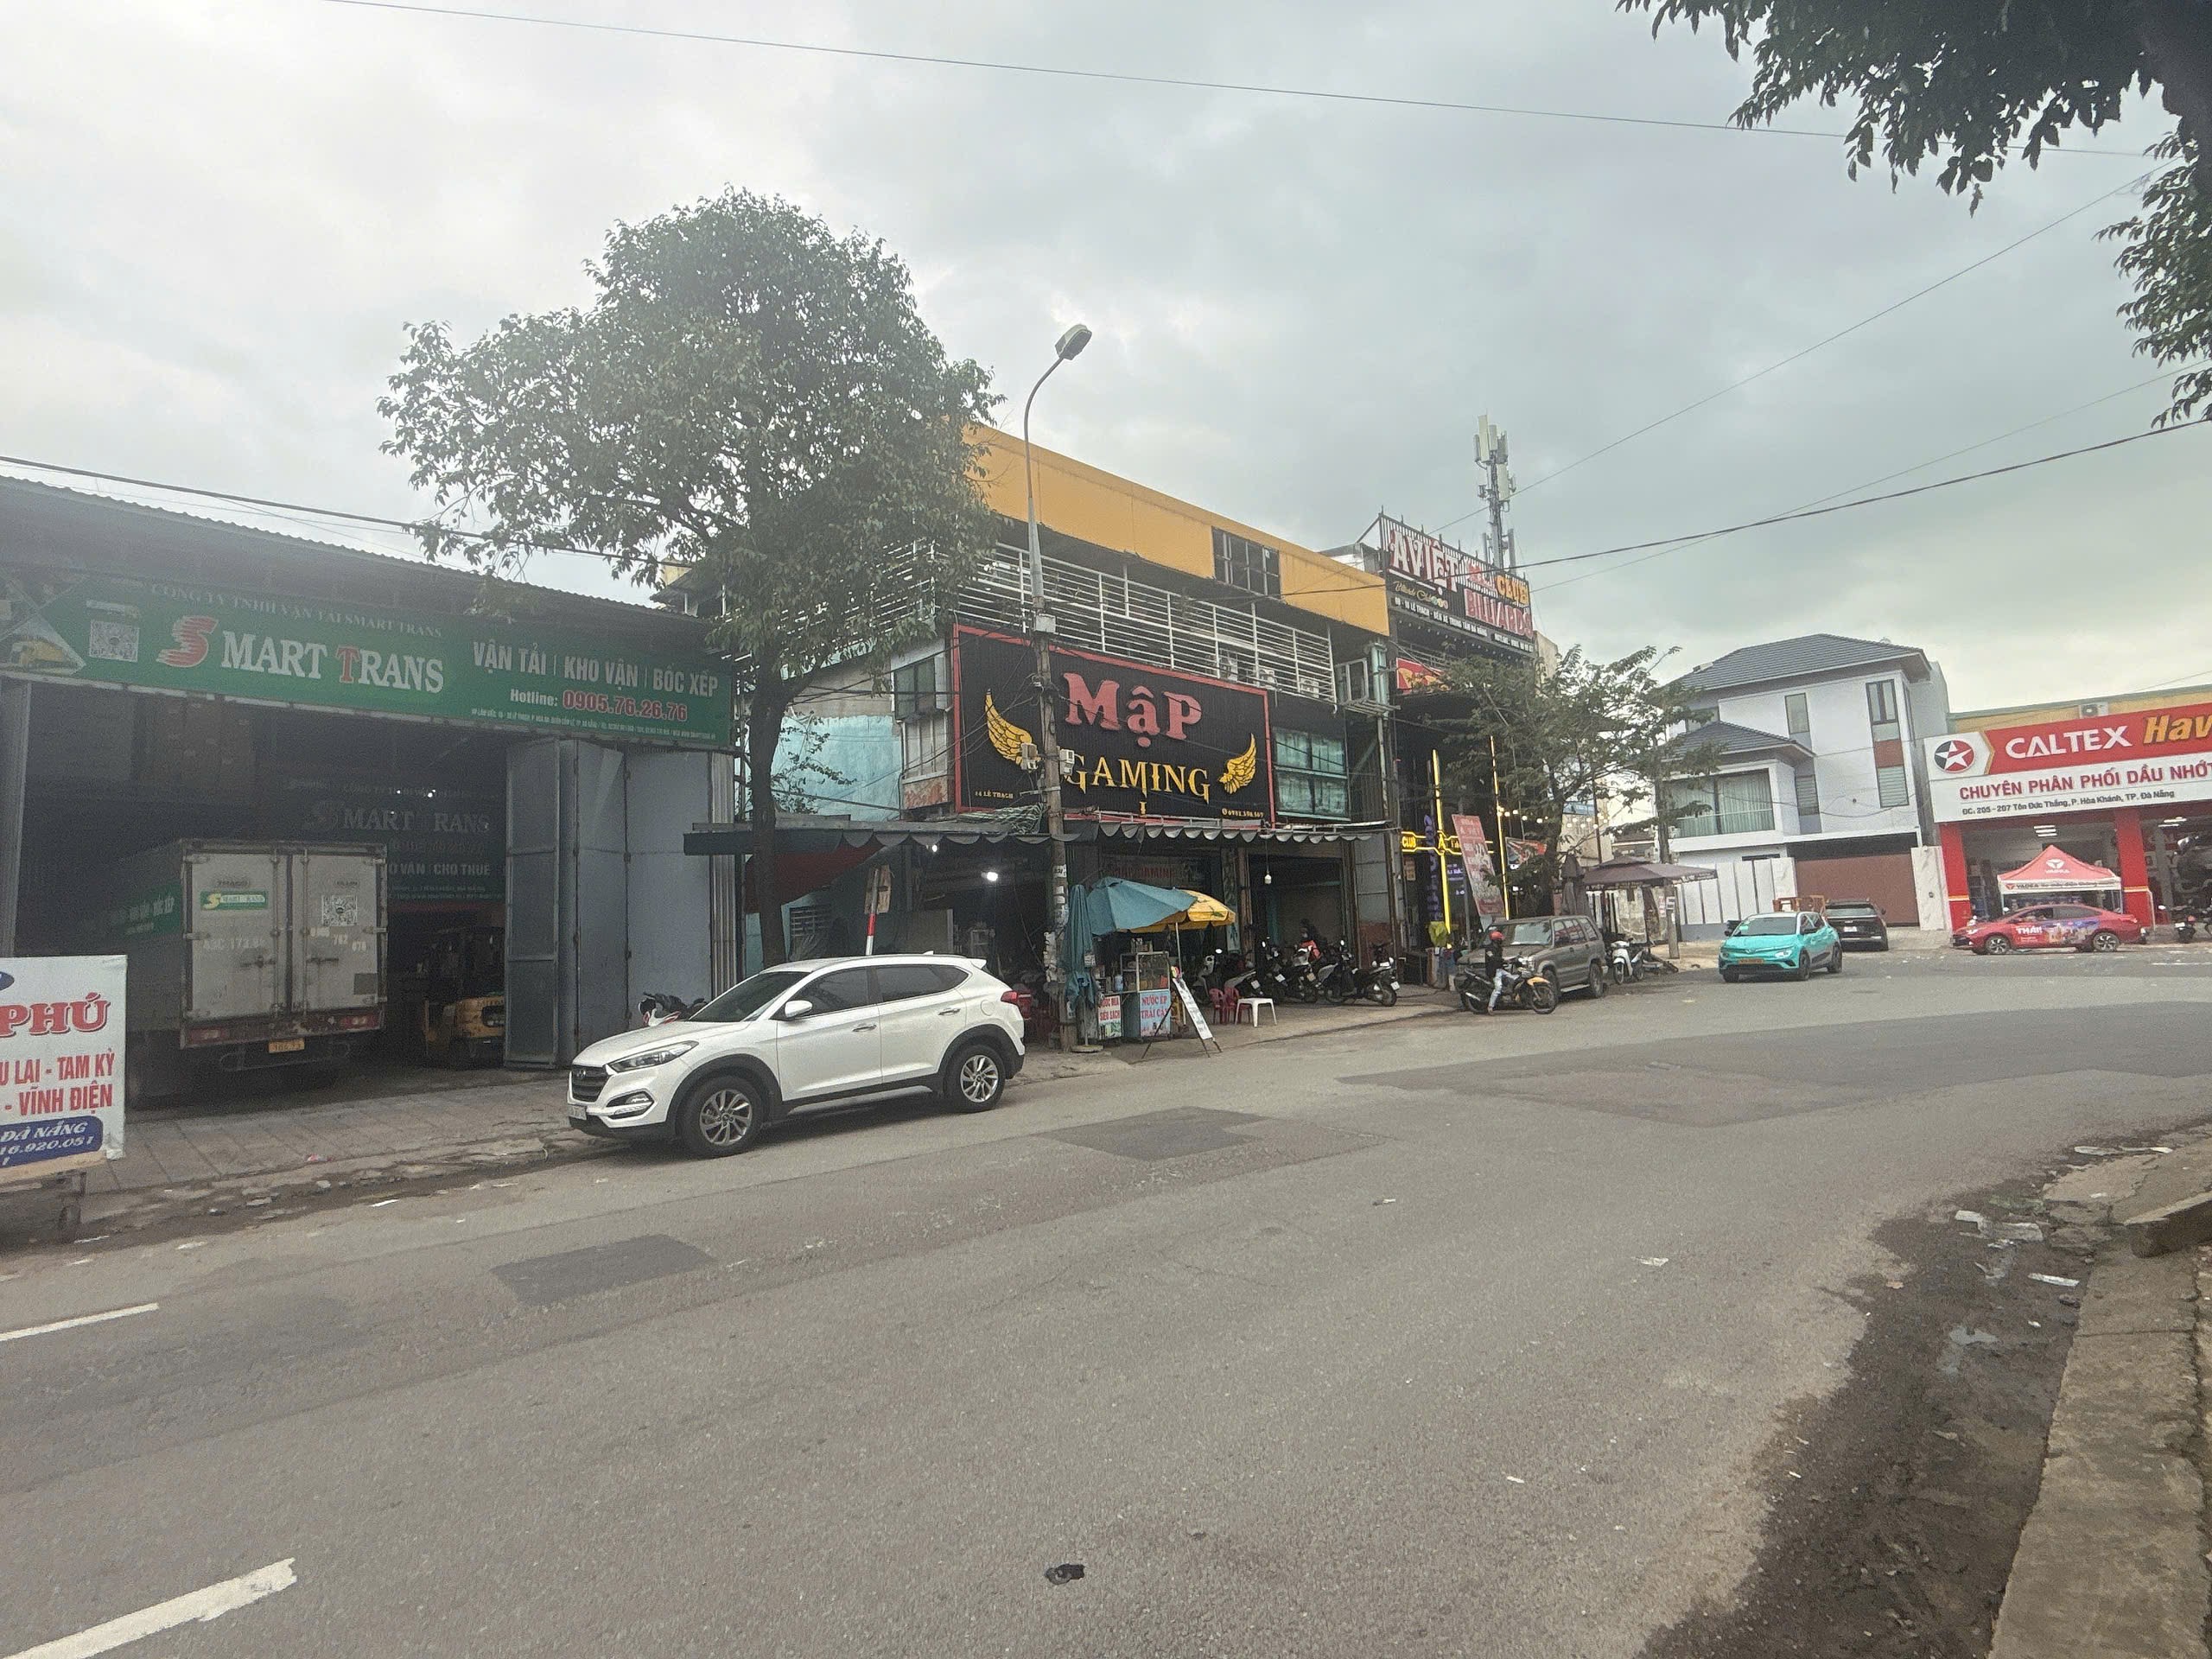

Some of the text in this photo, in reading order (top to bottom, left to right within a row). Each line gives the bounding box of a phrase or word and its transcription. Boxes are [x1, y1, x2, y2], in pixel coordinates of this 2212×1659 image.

[1497, 575, 1529, 607] CLUB
[336, 645, 444, 694] TRANS
[474, 639, 718, 697] VẬN TẢI KHO VẬN BỐC XẾP
[511, 689, 557, 707] Hotline:
[563, 689, 688, 722] 0905.76.26.76
[2005, 714, 2212, 760] CALTEX Hav
[1062, 753, 1210, 804] GAMING
[1960, 779, 2022, 800] CHUYÊN
[2028, 774, 2074, 794] PHÂN
[2080, 766, 2120, 787] PHỐI
[2126, 764, 2163, 784] DẦU
[1402, 836, 1416, 848] CLUB
[0, 991, 111, 1038] PHÚ
[15, 1058, 41, 1085] LAI
[57, 1054, 90, 1081] TAM
[19, 1086, 63, 1116] VĨNH
[69, 1080, 113, 1115] ĐIỆN
